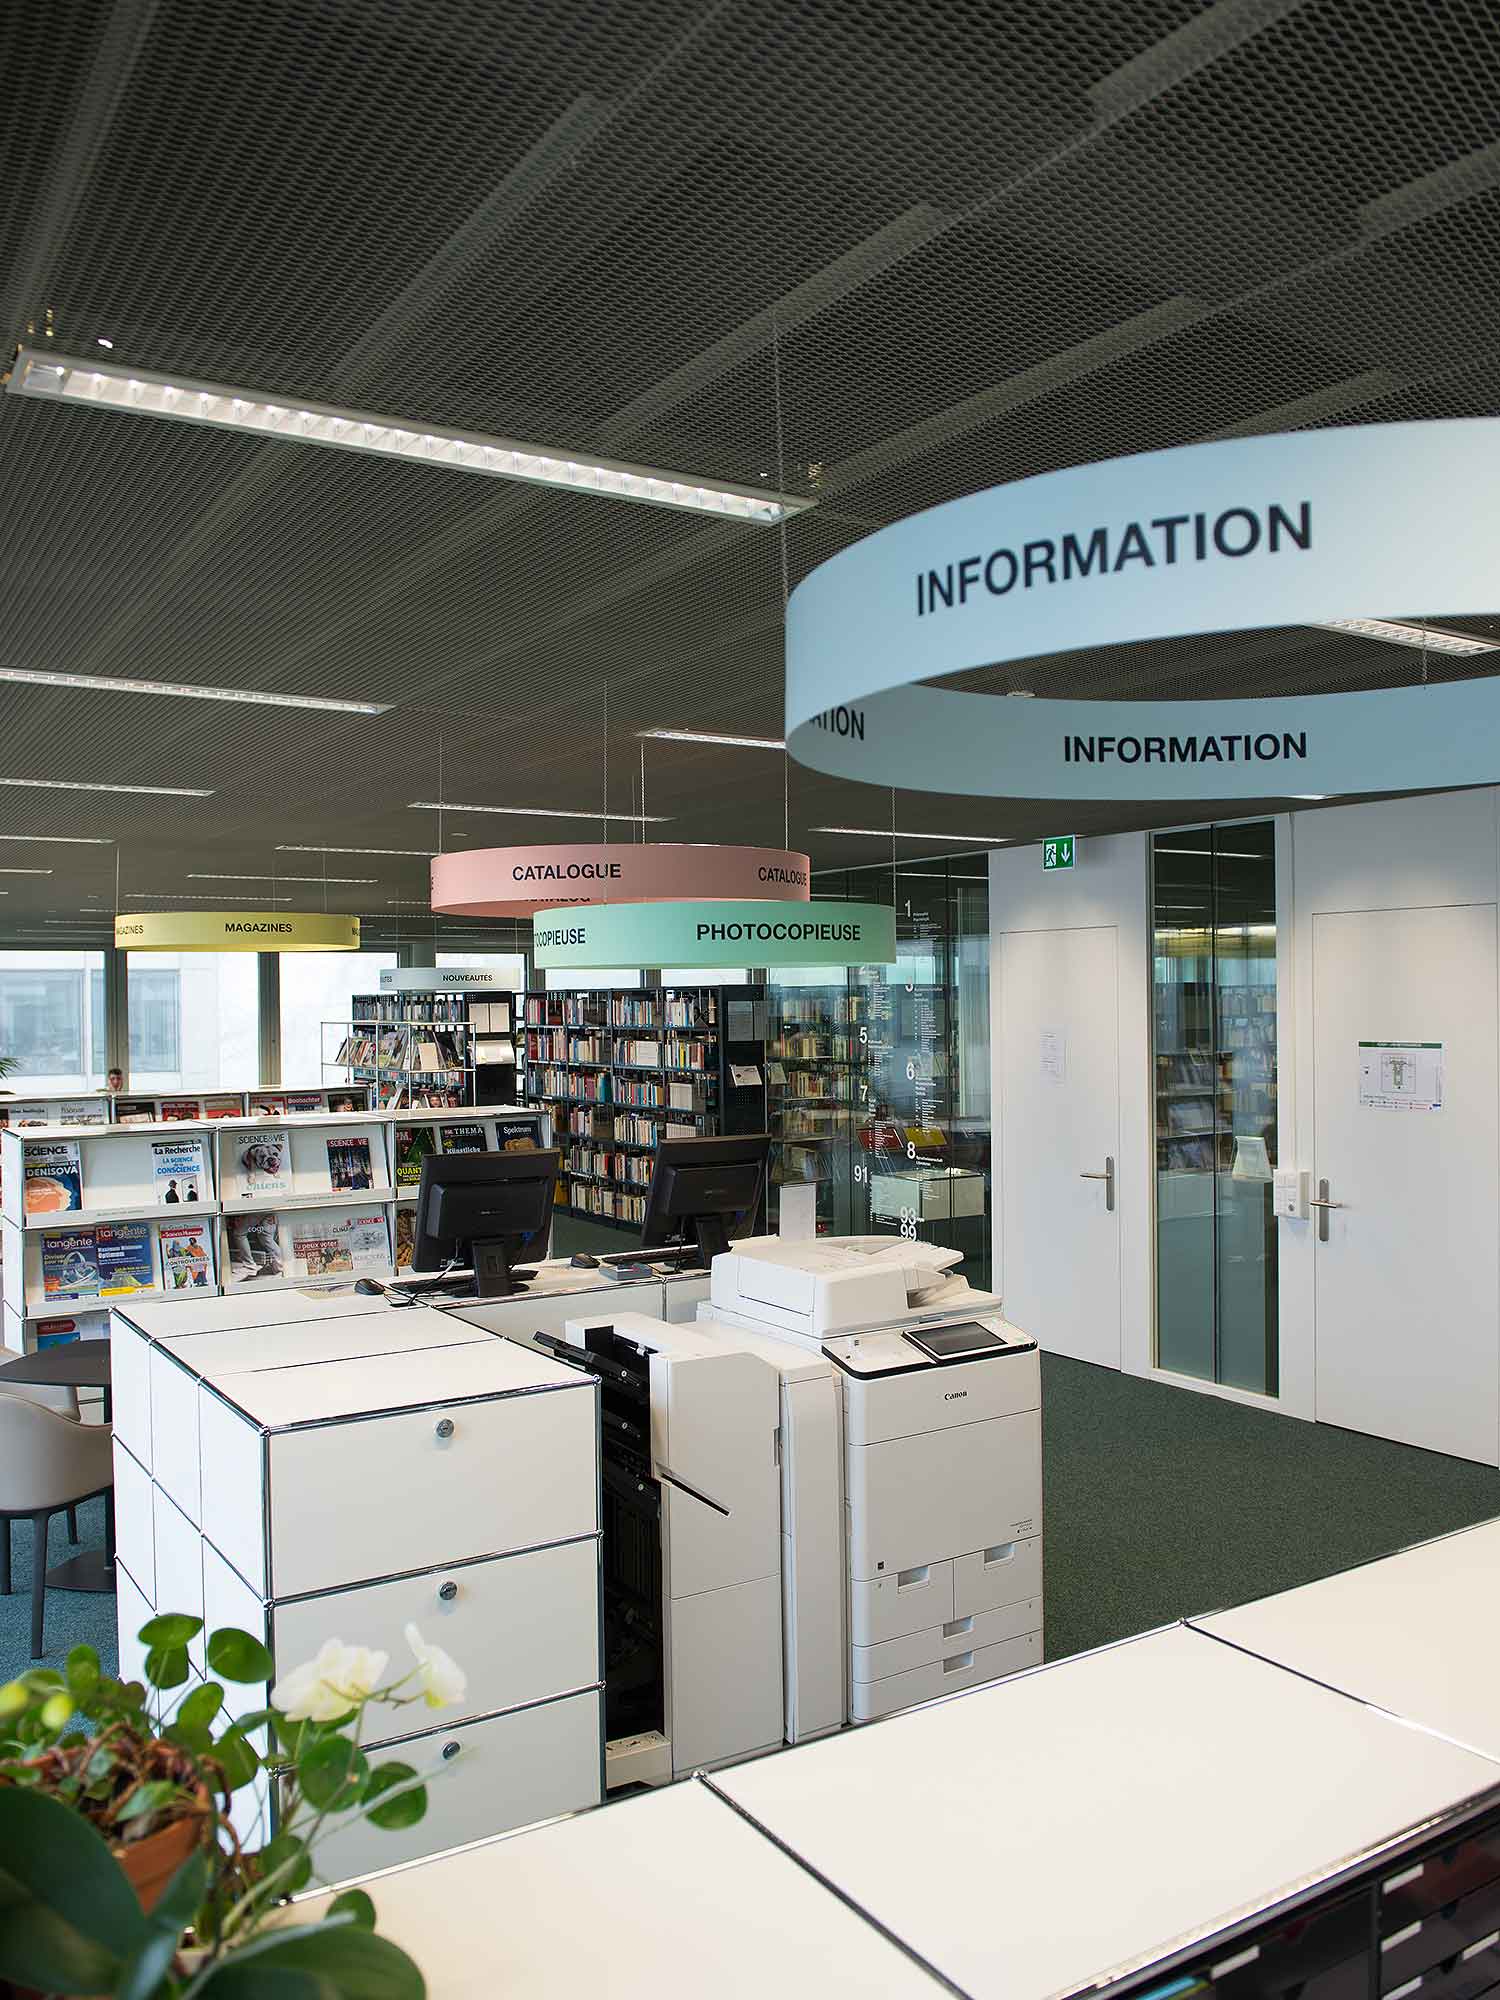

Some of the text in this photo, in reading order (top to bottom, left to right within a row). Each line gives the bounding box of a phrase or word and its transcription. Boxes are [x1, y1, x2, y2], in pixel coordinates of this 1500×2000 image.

[916, 501, 1312, 617] INFORMATION
[1063, 731, 1308, 764] INFORMATION
[512, 863, 622, 881] CATALOGUE
[758, 867, 807, 886] CATALOGUE
[905, 899, 912, 918] 1
[224, 922, 293, 933] MAGAZINES
[696, 923, 862, 941] PHOTOCOPIEUSE
[859, 1026, 868, 1044] 5
[906, 1061, 915, 1081] 6
[860, 1084, 869, 1102] 7
[24, 1145, 68, 1157] SCIENCE
[154, 1145, 201, 1155] La Recherche
[907, 1141, 916, 1160] 8
[27, 1166, 78, 1177] DENISOVA
[157, 1165, 201, 1174] CONSCIENCE
[854, 1165, 868, 1183] 91
[900, 1206, 917, 1225] 93
[100, 1226, 146, 1238] tangente
[900, 1223, 917, 1241] 99
[944, 1389, 967, 1400] Canon
